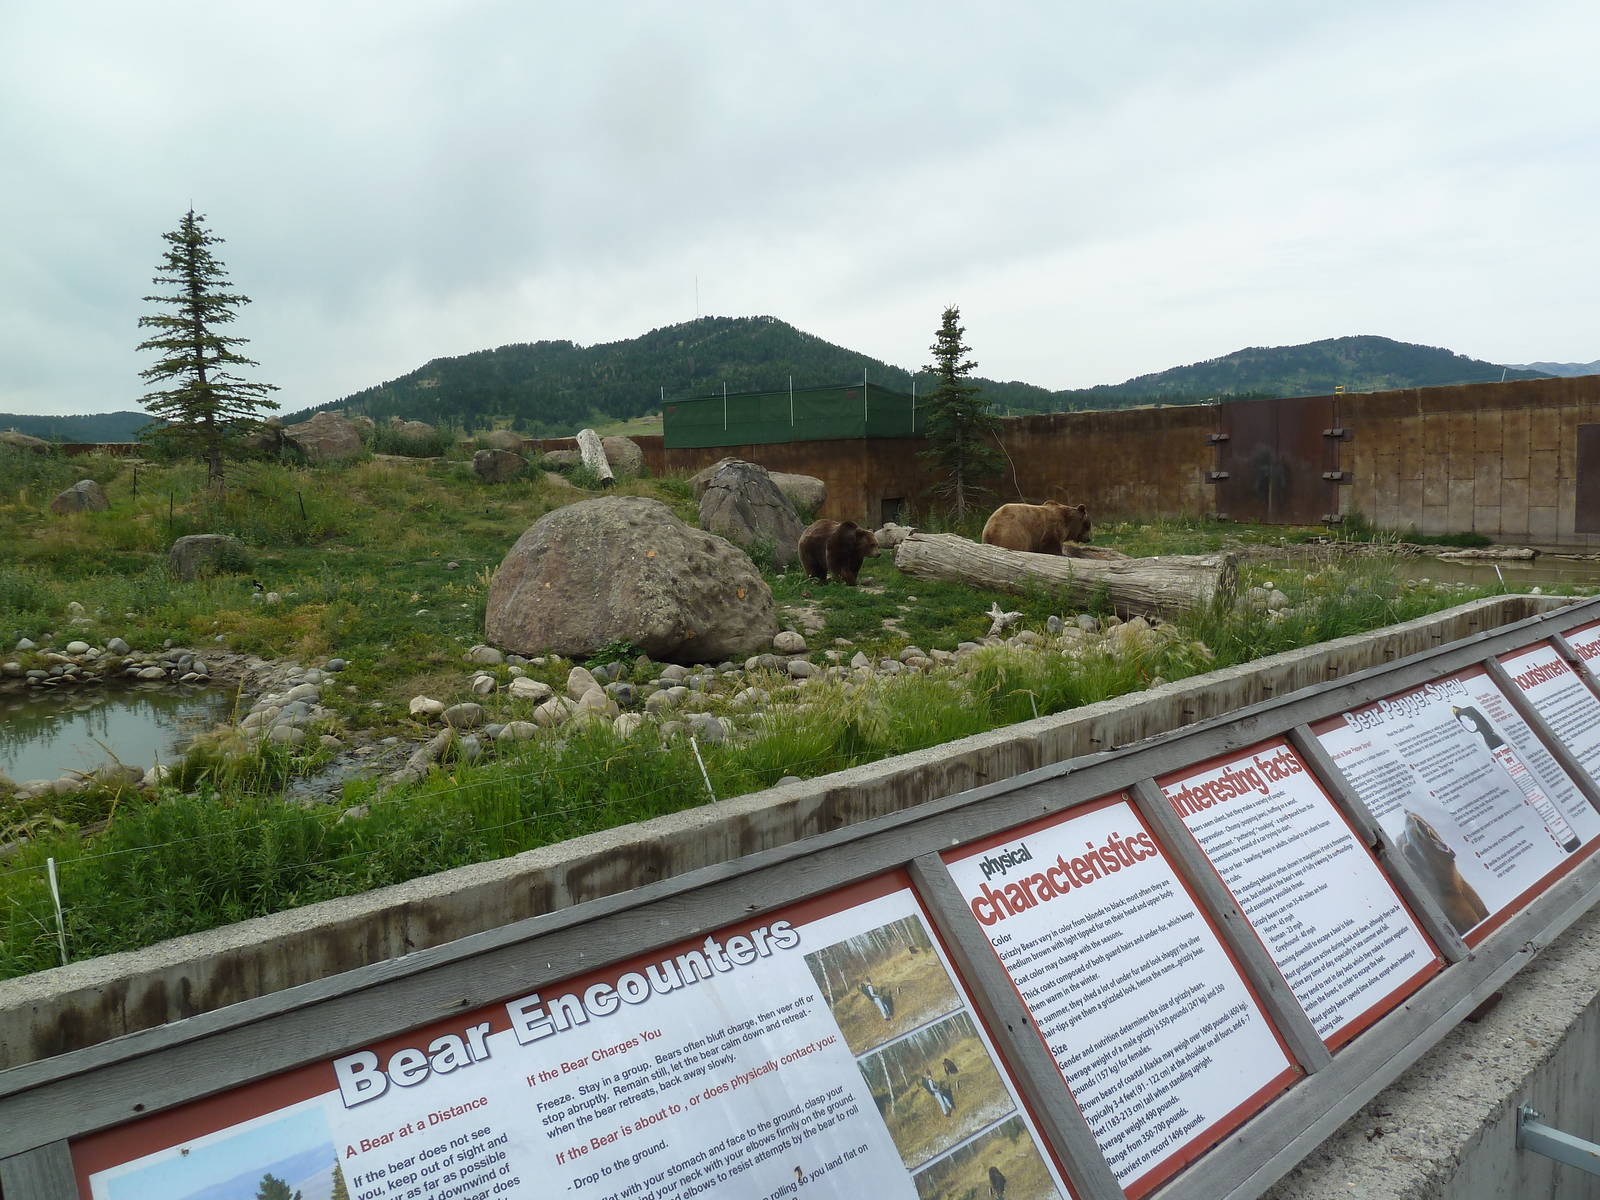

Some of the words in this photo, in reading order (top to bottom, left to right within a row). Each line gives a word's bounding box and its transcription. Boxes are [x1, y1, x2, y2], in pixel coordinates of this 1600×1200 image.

[1511, 656, 1570, 691] nourishment
[1342, 711, 1384, 733] Bear
[1377, 690, 1431, 719] Pepper
[1424, 678, 1469, 702] Spray
[1161, 766, 1270, 819] interesting
[1252, 749, 1303, 783] facts
[970, 831, 1159, 926] characteristics
[979, 842, 1033, 881] physical
[991, 934, 1012, 947] Color
[1014, 974, 1030, 986] Coat
[1029, 967, 1045, 979] color
[1044, 961, 1058, 972] may
[1058, 951, 1079, 965] change
[1078, 944, 1092, 955] with
[1090, 940, 1102, 949] the
[1101, 930, 1123, 945] seasons.
[333, 1022, 492, 1108] Bear
[506, 918, 800, 1045] Encounters
[1029, 1000, 1046, 1013] them
[1045, 991, 1064, 1004] warm
[1069, 983, 1081, 992] the
[1079, 973, 1100, 987] winter.
[526, 1074, 536, 1088] If
[538, 1069, 559, 1083] the
[560, 1057, 588, 1074] Bear
[592, 1038, 639, 1061] Charges
[639, 1029, 662, 1042] You
[536, 1094, 575, 1113] Freeze.
[578, 1081, 600, 1096] Stay
[601, 1077, 612, 1086] in
[613, 1074, 620, 1082] a
[622, 1063, 652, 1080] group.
[654, 1049, 682, 1065] Bears
[683, 1039, 706, 1053] often
[705, 1029, 726, 1044] bluff
[727, 1019, 758, 1035] charge,
[757, 1011, 776, 1022] then
[776, 1003, 793, 1015] veer
[794, 997, 805, 1007] off
[806, 994, 814, 1003] or
[542, 1111, 565, 1126] stop
[567, 1093, 610, 1115] abruptly.
[613, 1076, 650, 1096] Remain
[650, 1067, 670, 1080] still,
[670, 1061, 683, 1072] let
[683, 1055, 699, 1066] the
[699, 1046, 719, 1060] bear
[721, 1038, 742, 1051] calm
[742, 1028, 765, 1042] down
[766, 1019, 781, 1032] and
[781, 1009, 807, 1026] retreat
[1051, 1044, 1068, 1057] Size
[546, 1122, 575, 1139] when
[576, 1114, 593, 1126] the
[594, 1103, 616, 1119] bear
[618, 1088, 659, 1109] retreats,
[658, 1075, 683, 1091] back
[683, 1066, 706, 1081] away
[707, 1054, 736, 1070] slowly.
[555, 1152, 566, 1166] If
[567, 1145, 588, 1160] the
[590, 1131, 618, 1150] Bear
[620, 1125, 632, 1137] is
[634, 1108, 668, 1131] about
[668, 1104, 681, 1115] to
[689, 1094, 700, 1106] or
[703, 1083, 729, 1100] does
[730, 1060, 778, 1090] physically
[780, 1043, 816, 1065] contact
[816, 1035, 836, 1052] you:
[1099, 1132, 1126, 1155] Average
[1124, 1117, 1146, 1135] weight
[1145, 1109, 1157, 1121] 490
[1156, 1095, 1180, 1116] pounds.
[346, 1145, 358, 1159] A
[360, 1131, 394, 1152] Bear
[399, 1123, 414, 1137] at
[416, 1121, 426, 1131] a
[428, 1097, 488, 1126] Distance
[353, 1175, 362, 1188] If
[365, 1169, 386, 1183] the
[388, 1156, 415, 1174] bear
[419, 1144, 448, 1161] does
[450, 1134, 469, 1149] not
[471, 1127, 491, 1140] see
[620, 1182, 643, 1199] with
[643, 1172, 664, 1190] your
[667, 1152, 707, 1176] stomach
[708, 1140, 727, 1156] and
[726, 1133, 746, 1148] face
[746, 1128, 757, 1137] to
[757, 1121, 772, 1132] the
[773, 1104, 804, 1127] ground,
[803, 1095, 826, 1109] clasp
[826, 1085, 843, 1101] your
[656, 1181, 677, 1199] your
[679, 1168, 703, 1186] neck
[703, 1158, 724, 1174] with
[724, 1148, 744, 1165] your
[746, 1133, 776, 1153] elbows
[776, 1121, 802, 1138] firmly
[800, 1113, 813, 1128] on
[812, 1109, 826, 1120] the
[826, 1092, 856, 1115] ground.
[683, 1178, 716, 1199] elbows
[716, 1172, 727, 1182] to
[728, 1158, 754, 1177] resist
[754, 1140, 792, 1164] attempts
[791, 1134, 802, 1144] by
[803, 1127, 819, 1139] the
[816, 1117, 835, 1132] bear
[836, 1112, 846, 1122] to
[845, 1104, 859, 1117] roll
[1113, 1157, 1142, 1184] Heaviest
[1141, 1153, 1151, 1163] on
[1149, 1137, 1170, 1157] record
[1168, 1127, 1184, 1143] 1496
[1183, 1114, 1205, 1134] pounds.
[387, 1172, 418, 1191] keep
[421, 1161, 441, 1177] out
[443, 1154, 454, 1167] of
[457, 1143, 485, 1161] sight
[487, 1132, 508, 1149] and
[406, 1187, 421, 1199] as
[423, 1178, 440, 1192] far
[443, 1172, 457, 1184] as
[459, 1151, 506, 1179] possible
[438, 1168, 497, 1200] downwind
[498, 1162, 510, 1175] of
[493, 1177, 520, 1194] does
[573, 1172, 600, 1189] Drop
[601, 1166, 612, 1176] to
[613, 1158, 630, 1171] the
[632, 1139, 669, 1164] ground.
[770, 1182, 798, 1200] rolling
[809, 1167, 825, 1182] you
[824, 1155, 844, 1172] land
[843, 1148, 858, 1162] flat
[855, 1144, 868, 1154] on
